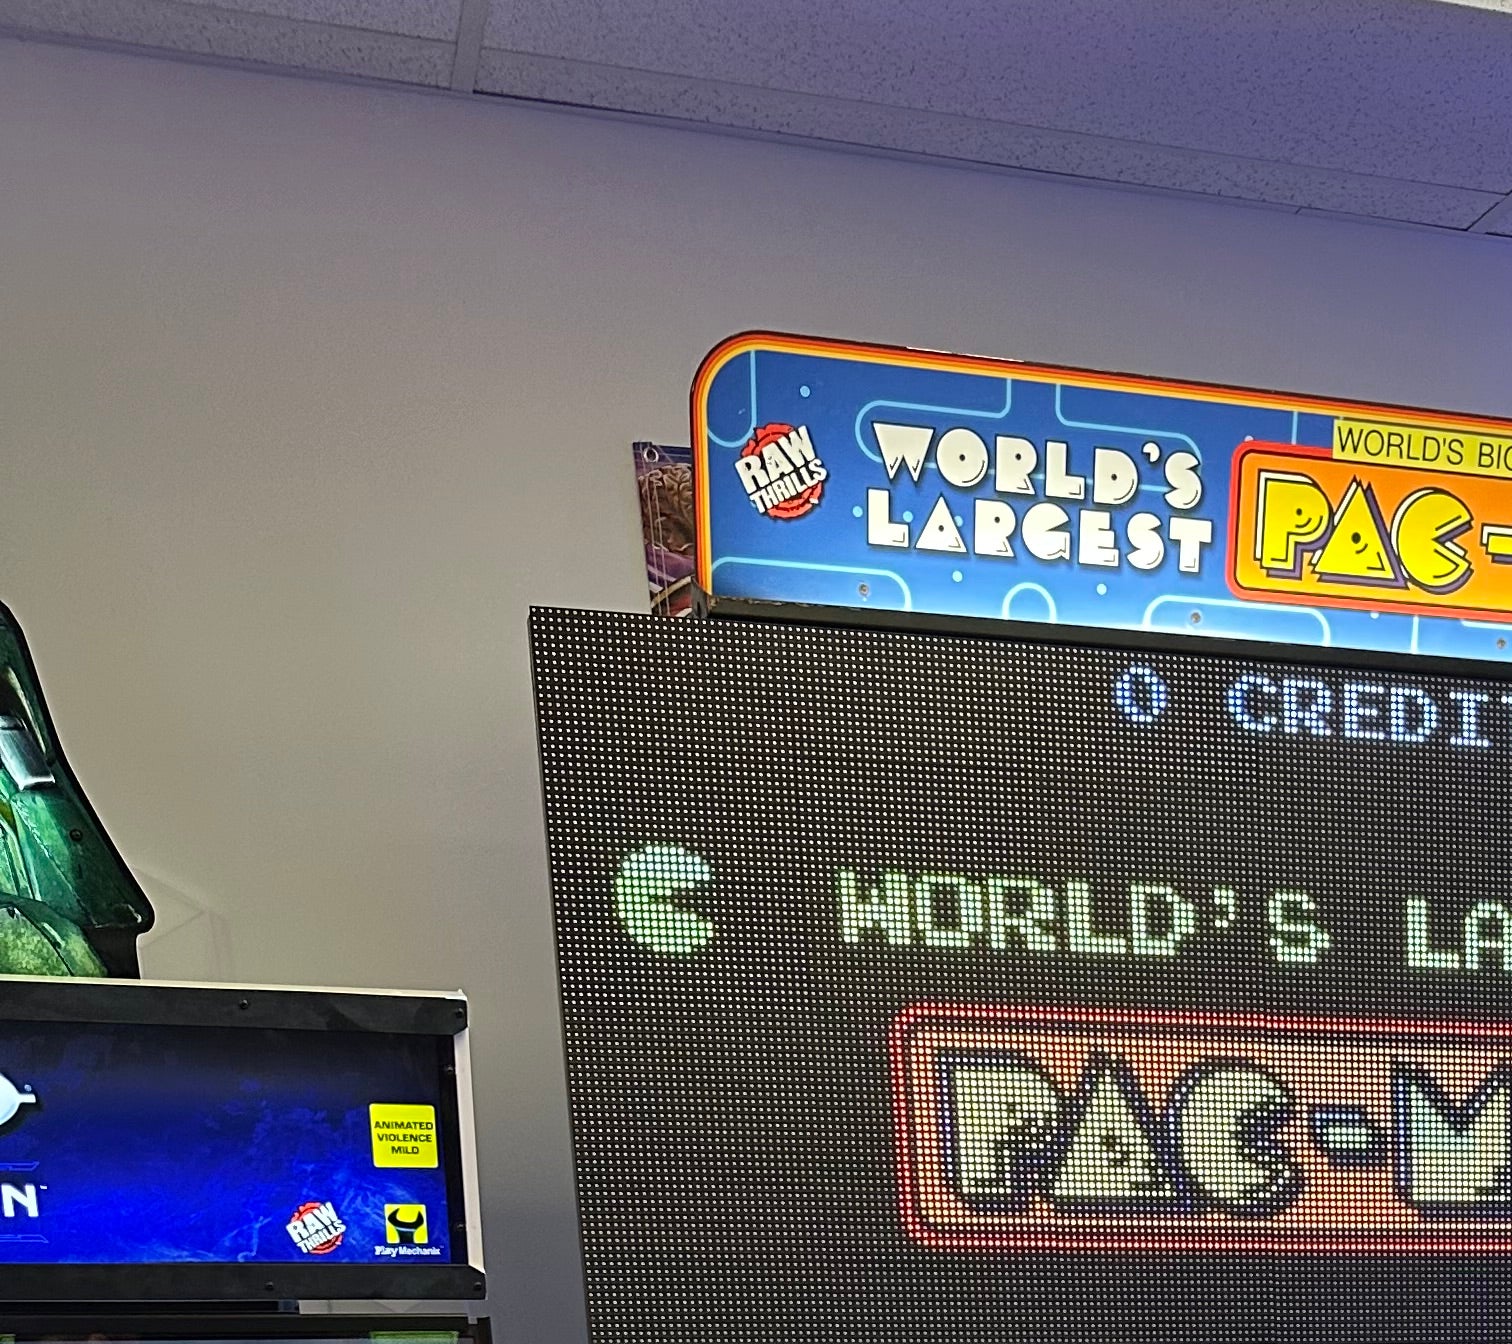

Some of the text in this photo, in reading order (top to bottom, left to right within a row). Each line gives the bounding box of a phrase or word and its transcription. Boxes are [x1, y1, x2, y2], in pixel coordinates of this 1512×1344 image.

[734, 426, 815, 496] RAW
[872, 421, 1202, 509] WORLD'S
[1337, 426, 1465, 466] WORLD'S
[749, 457, 828, 514] THRILLS
[867, 489, 1212, 572] LARGEST
[1115, 666, 1168, 724] 0
[838, 866, 1331, 967] WORLD'S
[374, 1121, 434, 1131] ANIMATED
[377, 1133, 433, 1143] VIOLENCE
[391, 1146, 420, 1155] MILD
[286, 1201, 338, 1244] RAW
